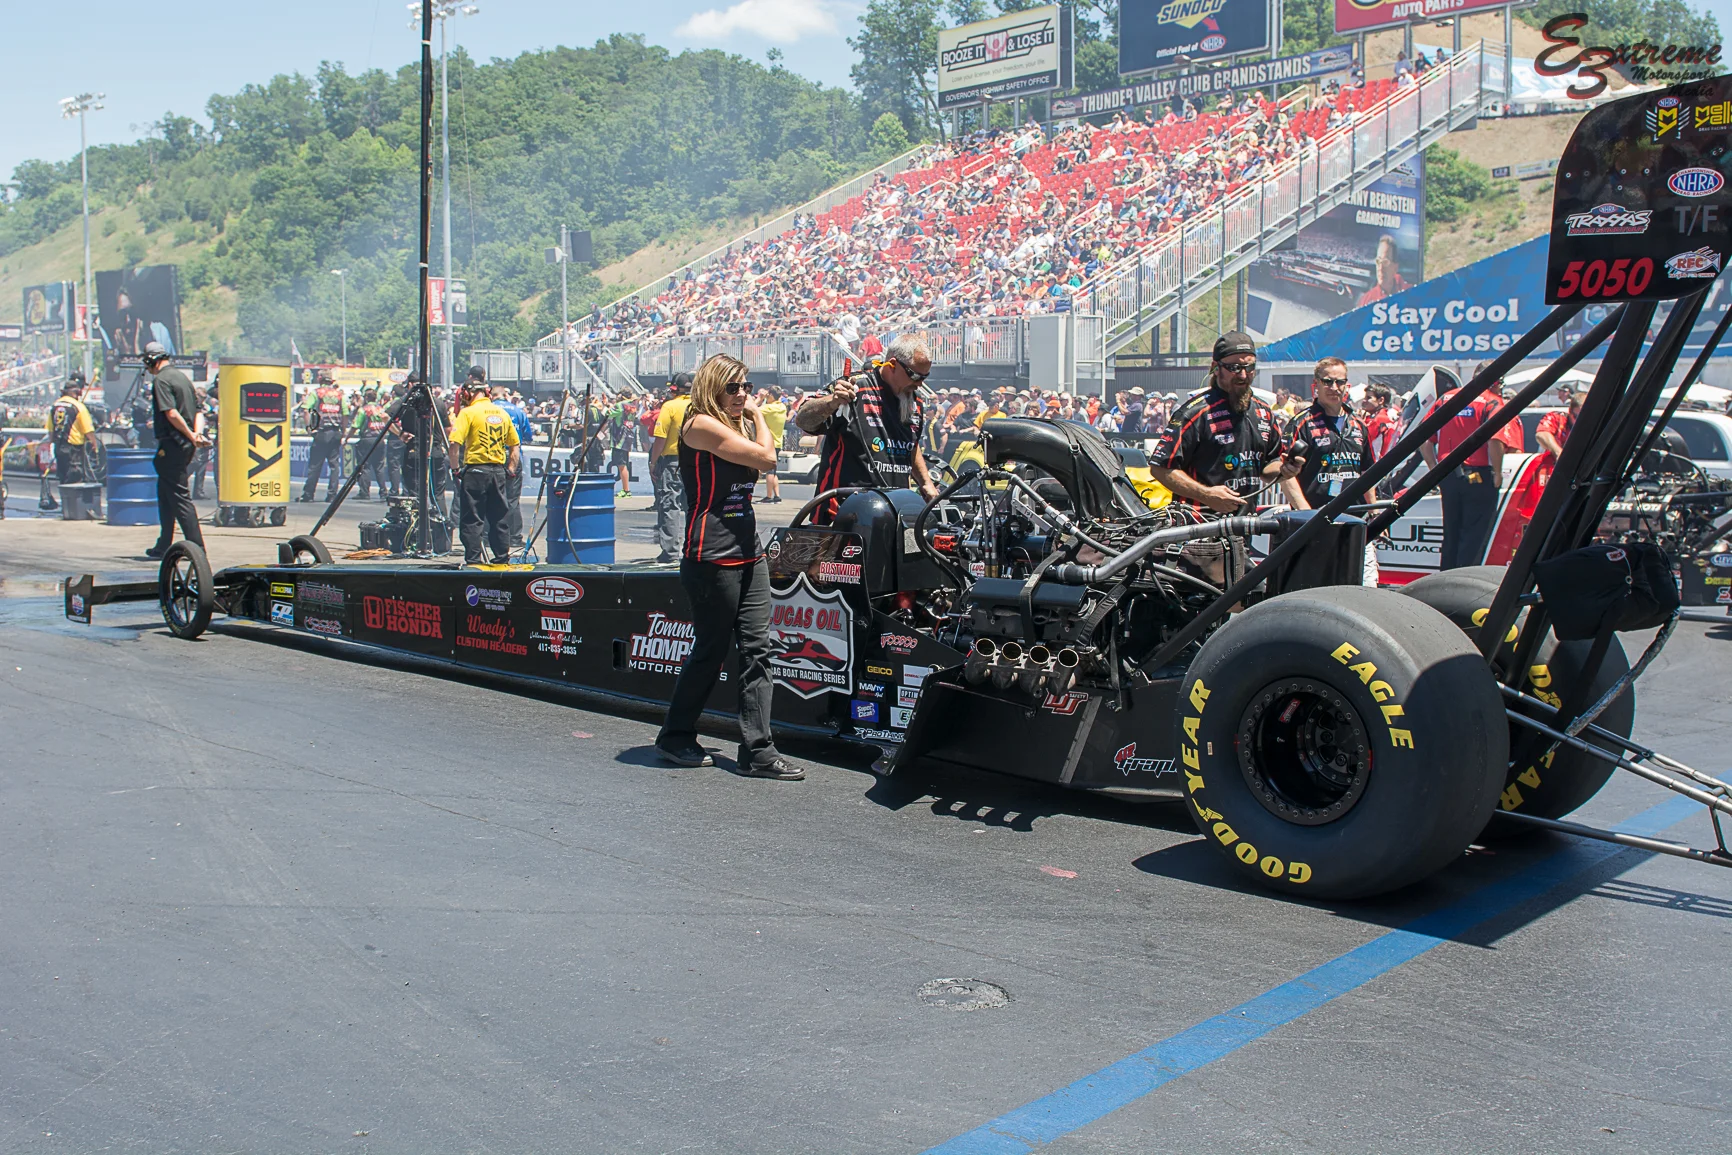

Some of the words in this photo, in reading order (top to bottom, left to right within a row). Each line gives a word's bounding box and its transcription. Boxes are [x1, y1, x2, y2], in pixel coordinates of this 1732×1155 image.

[1160, 0, 1222, 21] SUNOCO
[1392, 4, 1423, 18] AUTO
[943, 47, 973, 65] BOOZE
[976, 45, 984, 58] IT
[1007, 38, 1015, 51] &
[1017, 32, 1042, 49] LOSE
[1043, 30, 1054, 43] IT
[1202, 35, 1223, 51] NHRA
[945, 89, 980, 102] GOVERNOR'S
[980, 84, 1005, 95] HIGHWAY
[1006, 80, 1027, 91] SAFETY
[1028, 75, 1050, 86] OFFICE
[1081, 87, 1133, 114] THUNDER
[1136, 79, 1177, 104] VALLEY
[1213, 55, 1311, 88] GRANDSTANDS
[1659, 97, 1679, 107] NHRA
[1677, 173, 1715, 191] NHRA
[1369, 191, 1416, 214] BERNSTEIN
[1355, 209, 1401, 229] GRANDSTAND
[1568, 212, 1649, 229] TRAXXAS
[1674, 204, 1719, 237] T/F
[1557, 257, 1654, 298] 5050
[1371, 302, 1437, 331] Stay
[1443, 298, 1519, 324] Cool
[1362, 329, 1414, 353] Get
[820, 562, 861, 577] BOSTWICK
[384, 598, 442, 622] FISCHER
[816, 608, 841, 631] OIL
[385, 614, 443, 639] HONDA
[466, 613, 515, 643] Woody's
[544, 617, 568, 632] VMW
[648, 612, 697, 650] Tommy
[456, 635, 489, 650] CUSTOM
[489, 640, 528, 656] HEADERS
[631, 635, 692, 662] THOMP
[881, 634, 918, 649] VOODOO
[782, 667, 798, 679] BOAT
[799, 670, 822, 682] RACING
[823, 673, 846, 685] SERIES
[867, 665, 893, 676] GEICO
[1330, 641, 1415, 750] EAGLE
